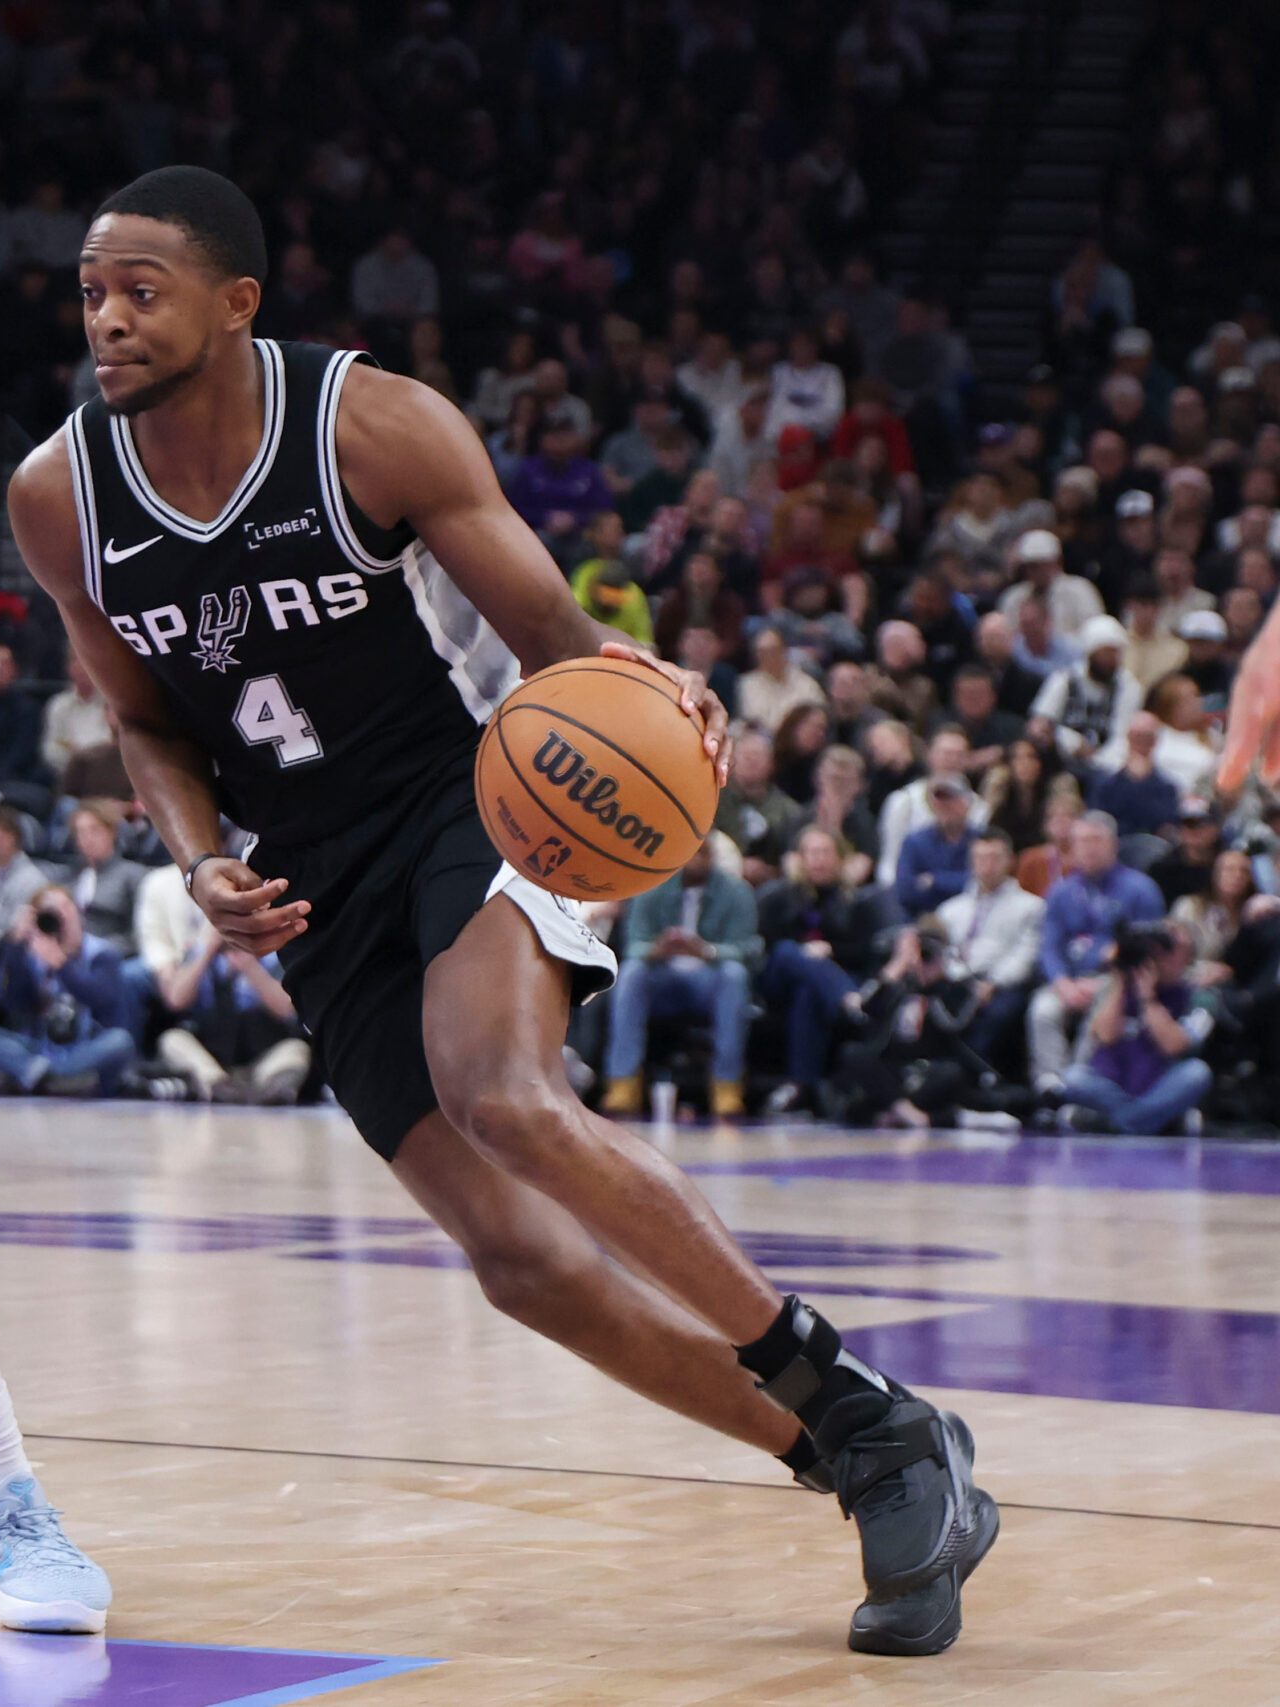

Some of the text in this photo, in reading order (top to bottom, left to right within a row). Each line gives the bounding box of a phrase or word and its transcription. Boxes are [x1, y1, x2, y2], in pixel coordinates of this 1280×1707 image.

[254, 517, 310, 541] LEDGER
[231, 672, 325, 769] 4
[531, 727, 666, 859] Wilson
